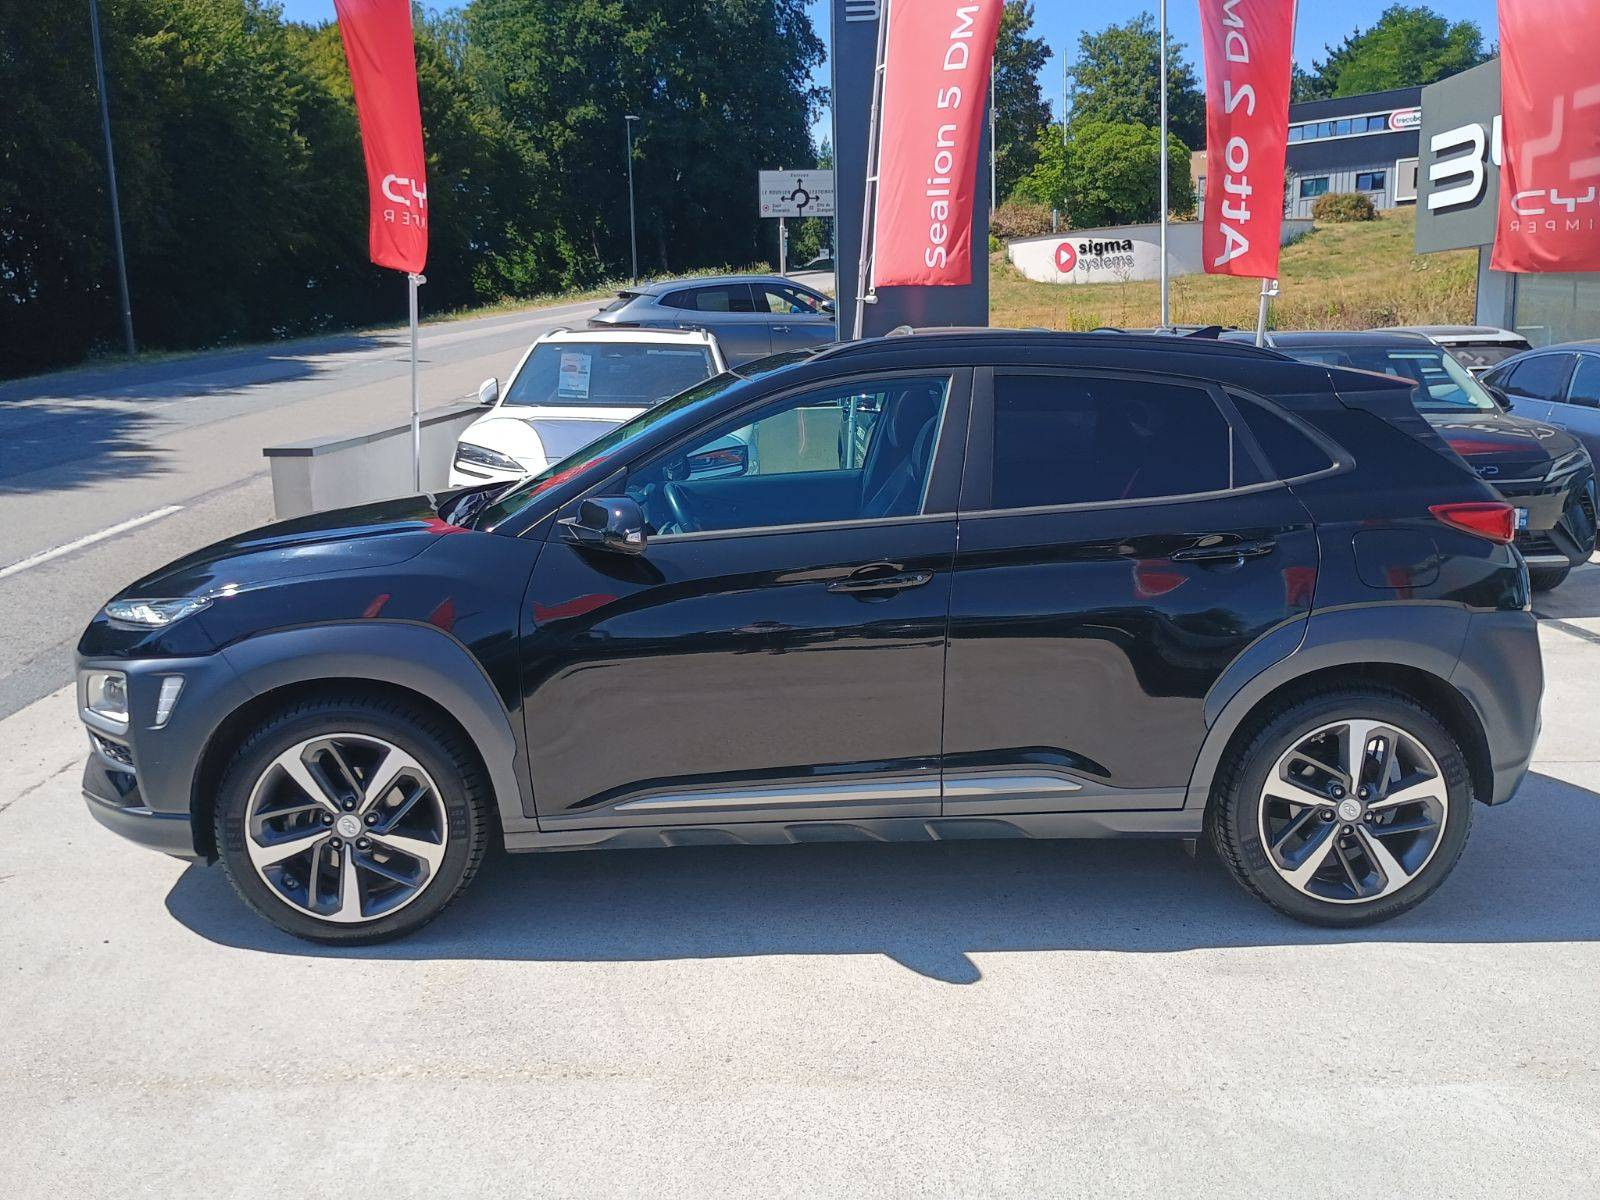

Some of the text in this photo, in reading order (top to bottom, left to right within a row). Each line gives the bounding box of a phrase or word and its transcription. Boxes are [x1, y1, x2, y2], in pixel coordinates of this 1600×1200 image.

[924, 0, 980, 269] Sealion 5 DM
[1078, 239, 1134, 256] sigma
[1078, 254, 1135, 272] systems
